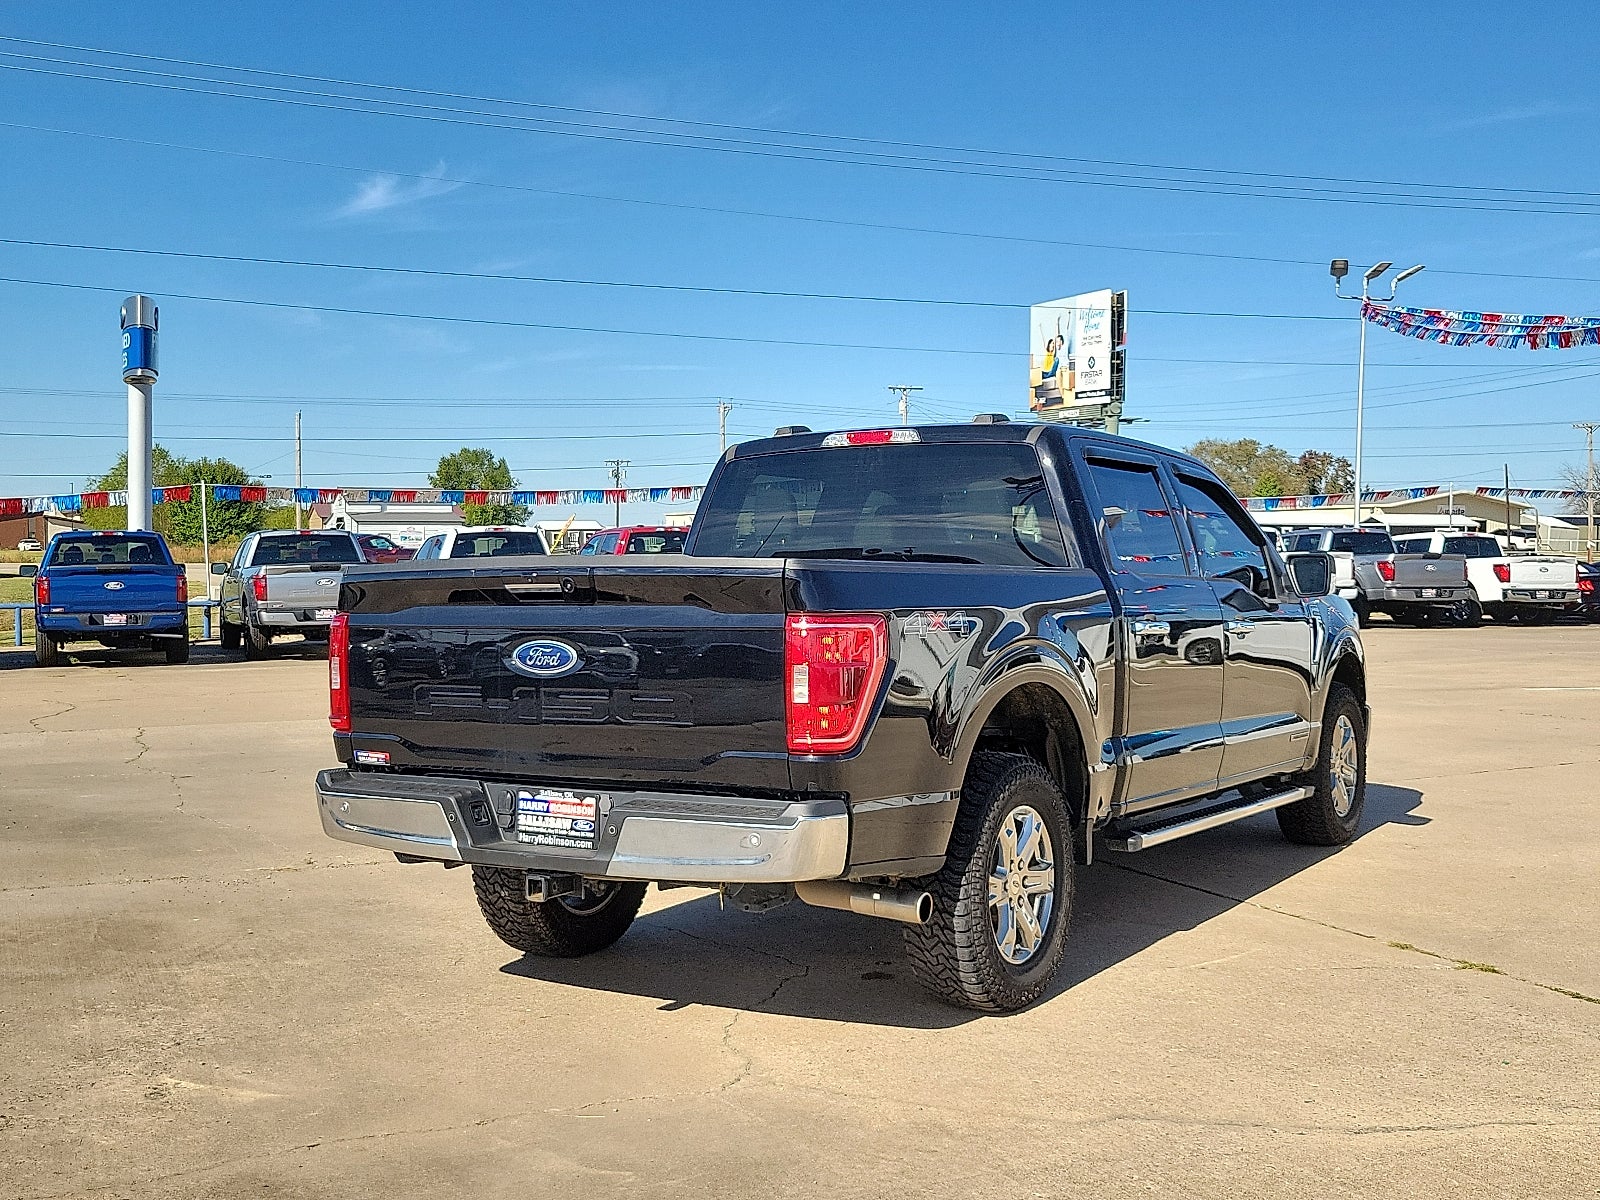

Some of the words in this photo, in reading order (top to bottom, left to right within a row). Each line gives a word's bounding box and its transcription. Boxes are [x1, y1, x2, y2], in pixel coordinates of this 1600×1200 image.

[526, 646, 561, 666] Ford
[519, 800, 549, 812] HARRY
[549, 802, 594, 816] ROBINSON
[518, 814, 572, 830] SALLISAW
[518, 832, 593, 849] HarryRobinson.com
